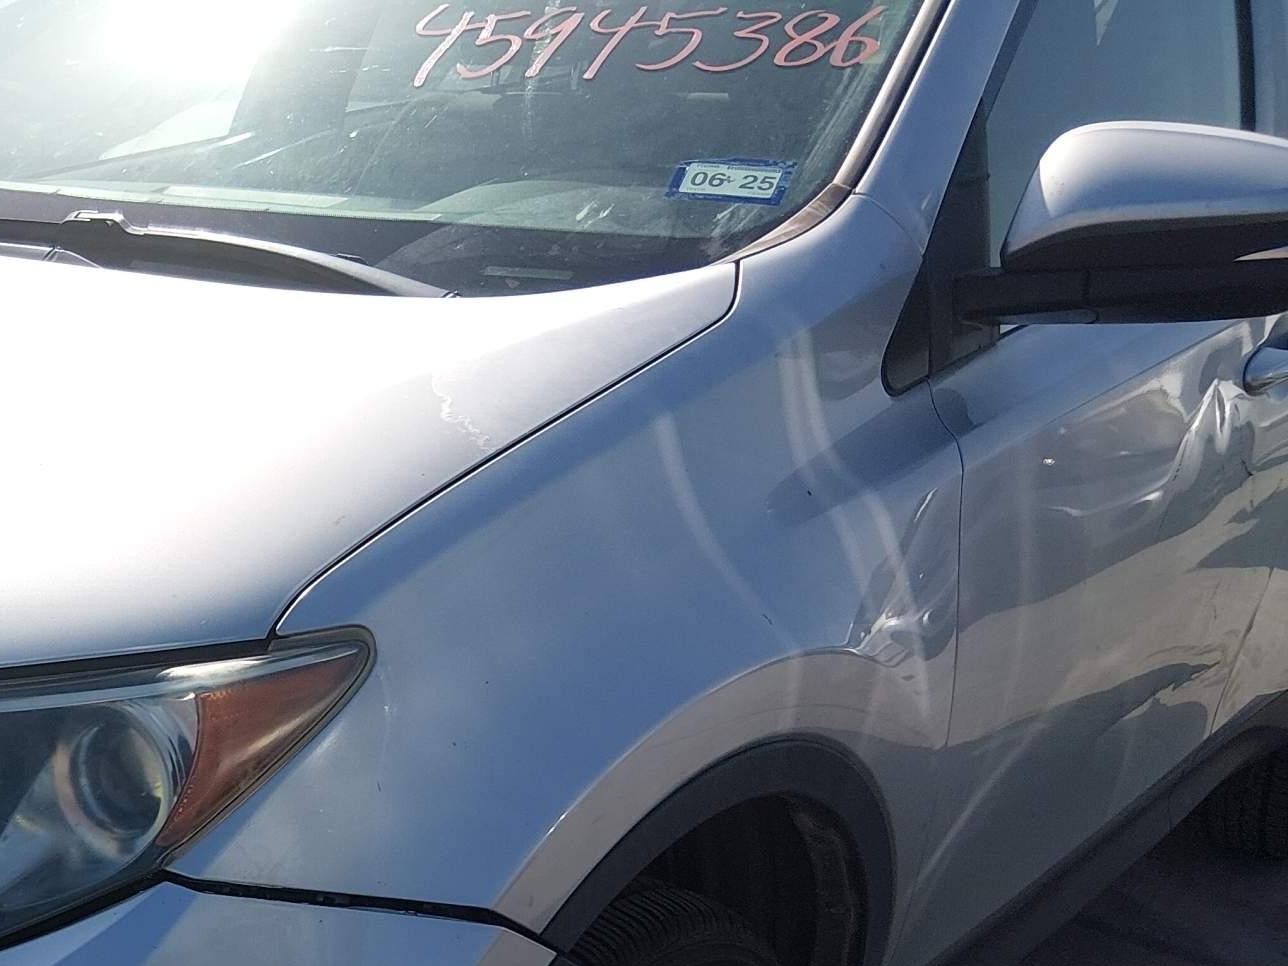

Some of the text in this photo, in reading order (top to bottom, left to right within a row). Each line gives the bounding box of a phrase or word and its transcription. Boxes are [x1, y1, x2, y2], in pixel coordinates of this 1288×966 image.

[413, 4, 881, 87] 45945386
[690, 171, 777, 191] 06 25
